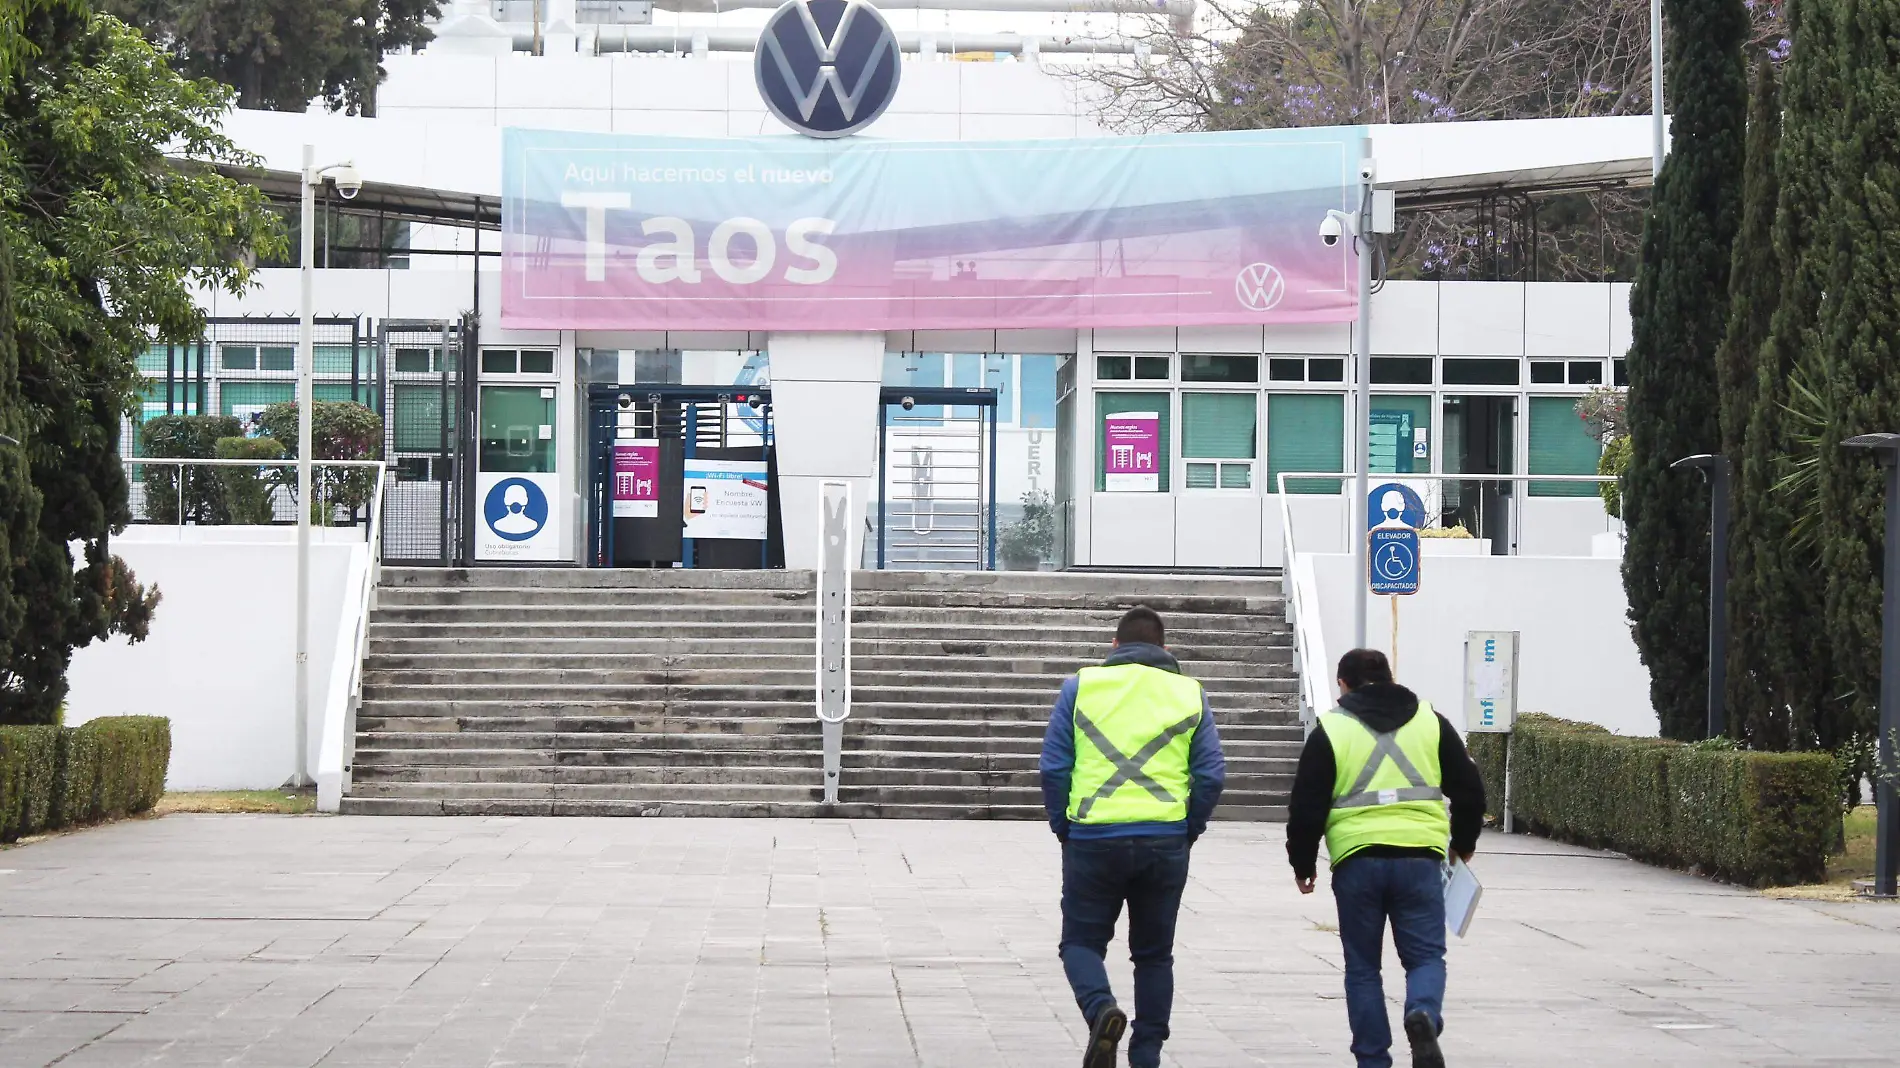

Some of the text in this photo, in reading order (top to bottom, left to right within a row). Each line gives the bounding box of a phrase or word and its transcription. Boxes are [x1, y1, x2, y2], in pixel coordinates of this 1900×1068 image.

[623, 163, 727, 183] hacemos
[734, 164, 755, 183] el
[762, 167, 834, 184] nuevo
[560, 191, 839, 285] Taos
[1236, 263, 1284, 310] VW
[1377, 532, 1411, 540] ELEVADOR
